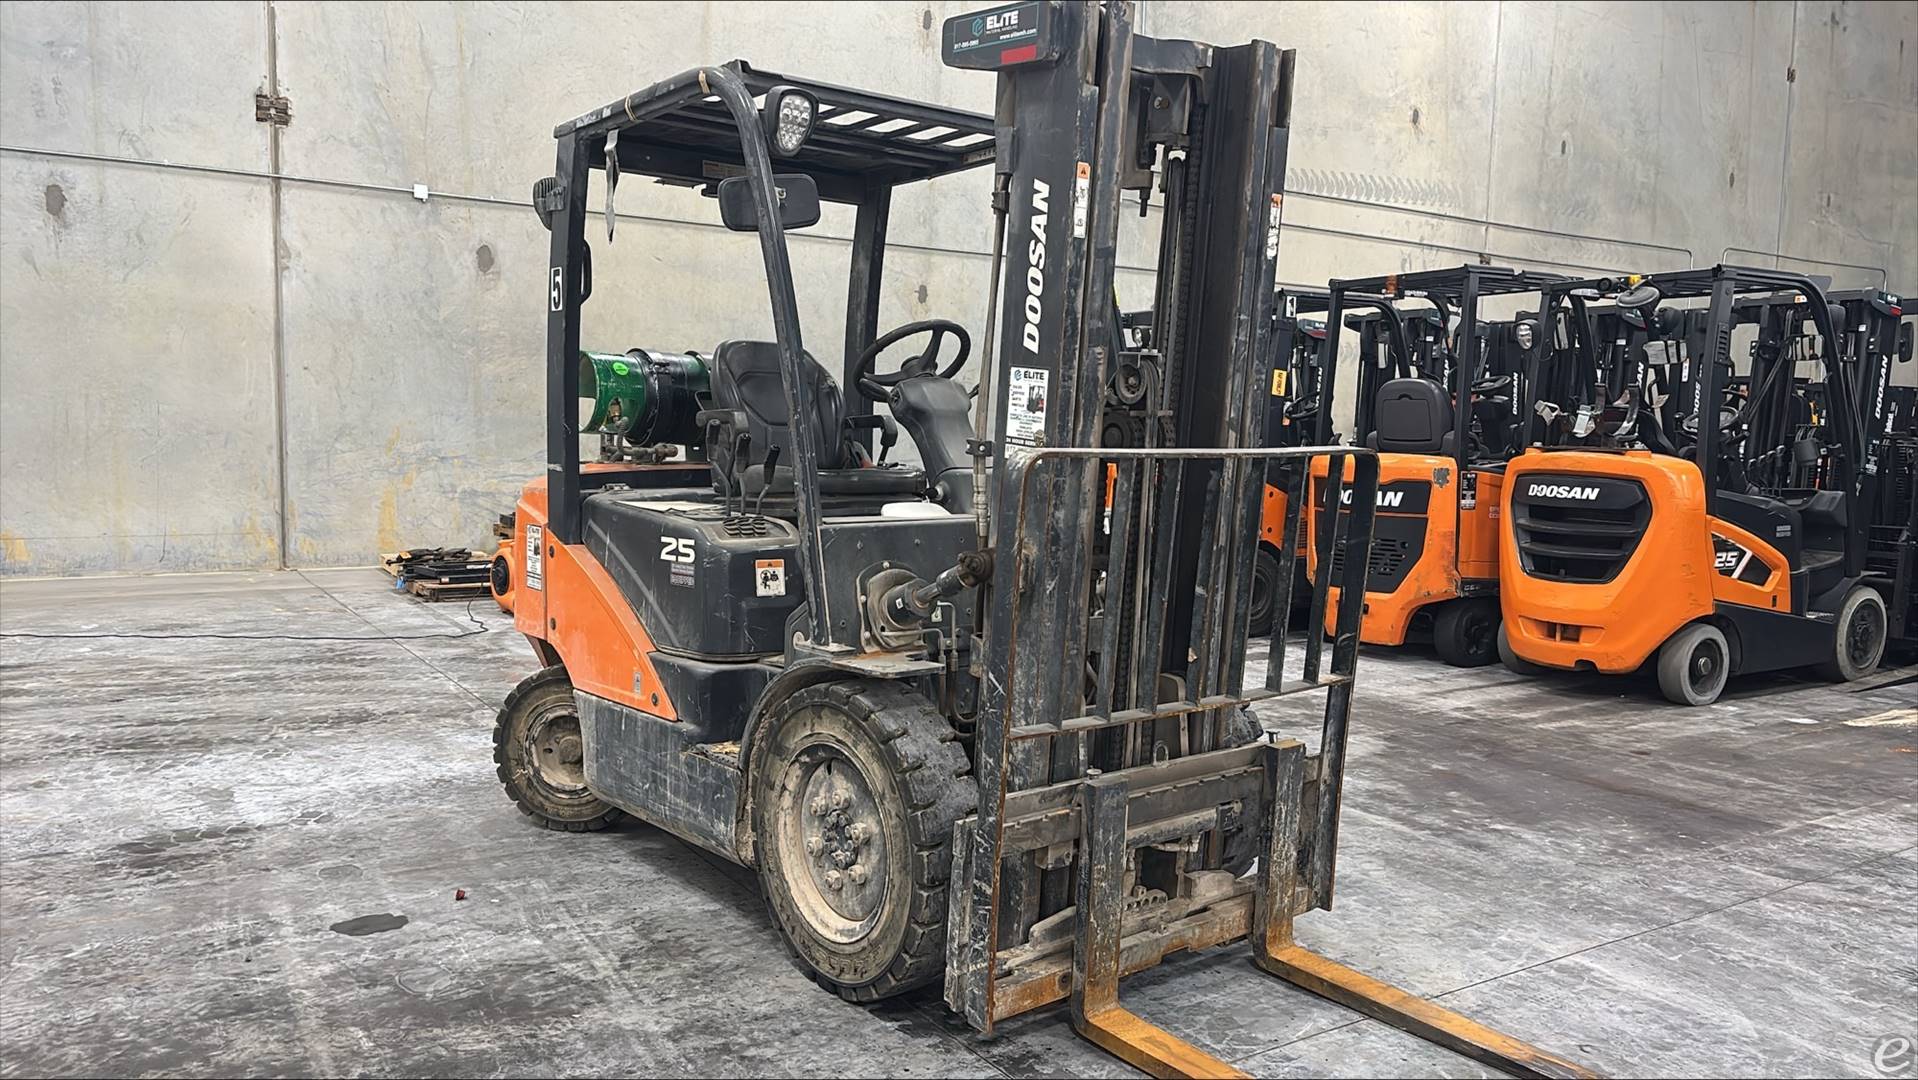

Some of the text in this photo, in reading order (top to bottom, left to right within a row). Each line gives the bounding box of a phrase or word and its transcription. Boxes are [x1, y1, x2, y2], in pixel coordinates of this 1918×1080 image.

[986, 10, 1019, 30] ELITE
[1022, 178, 1050, 355] DOOSAN
[553, 268, 561, 310] 5
[1023, 371, 1045, 381] ELITE
[1874, 354, 1889, 420] DOOSAN
[1528, 484, 1600, 500] DOOSAN
[660, 536, 696, 563] 25
[1714, 551, 1739, 569] 25
